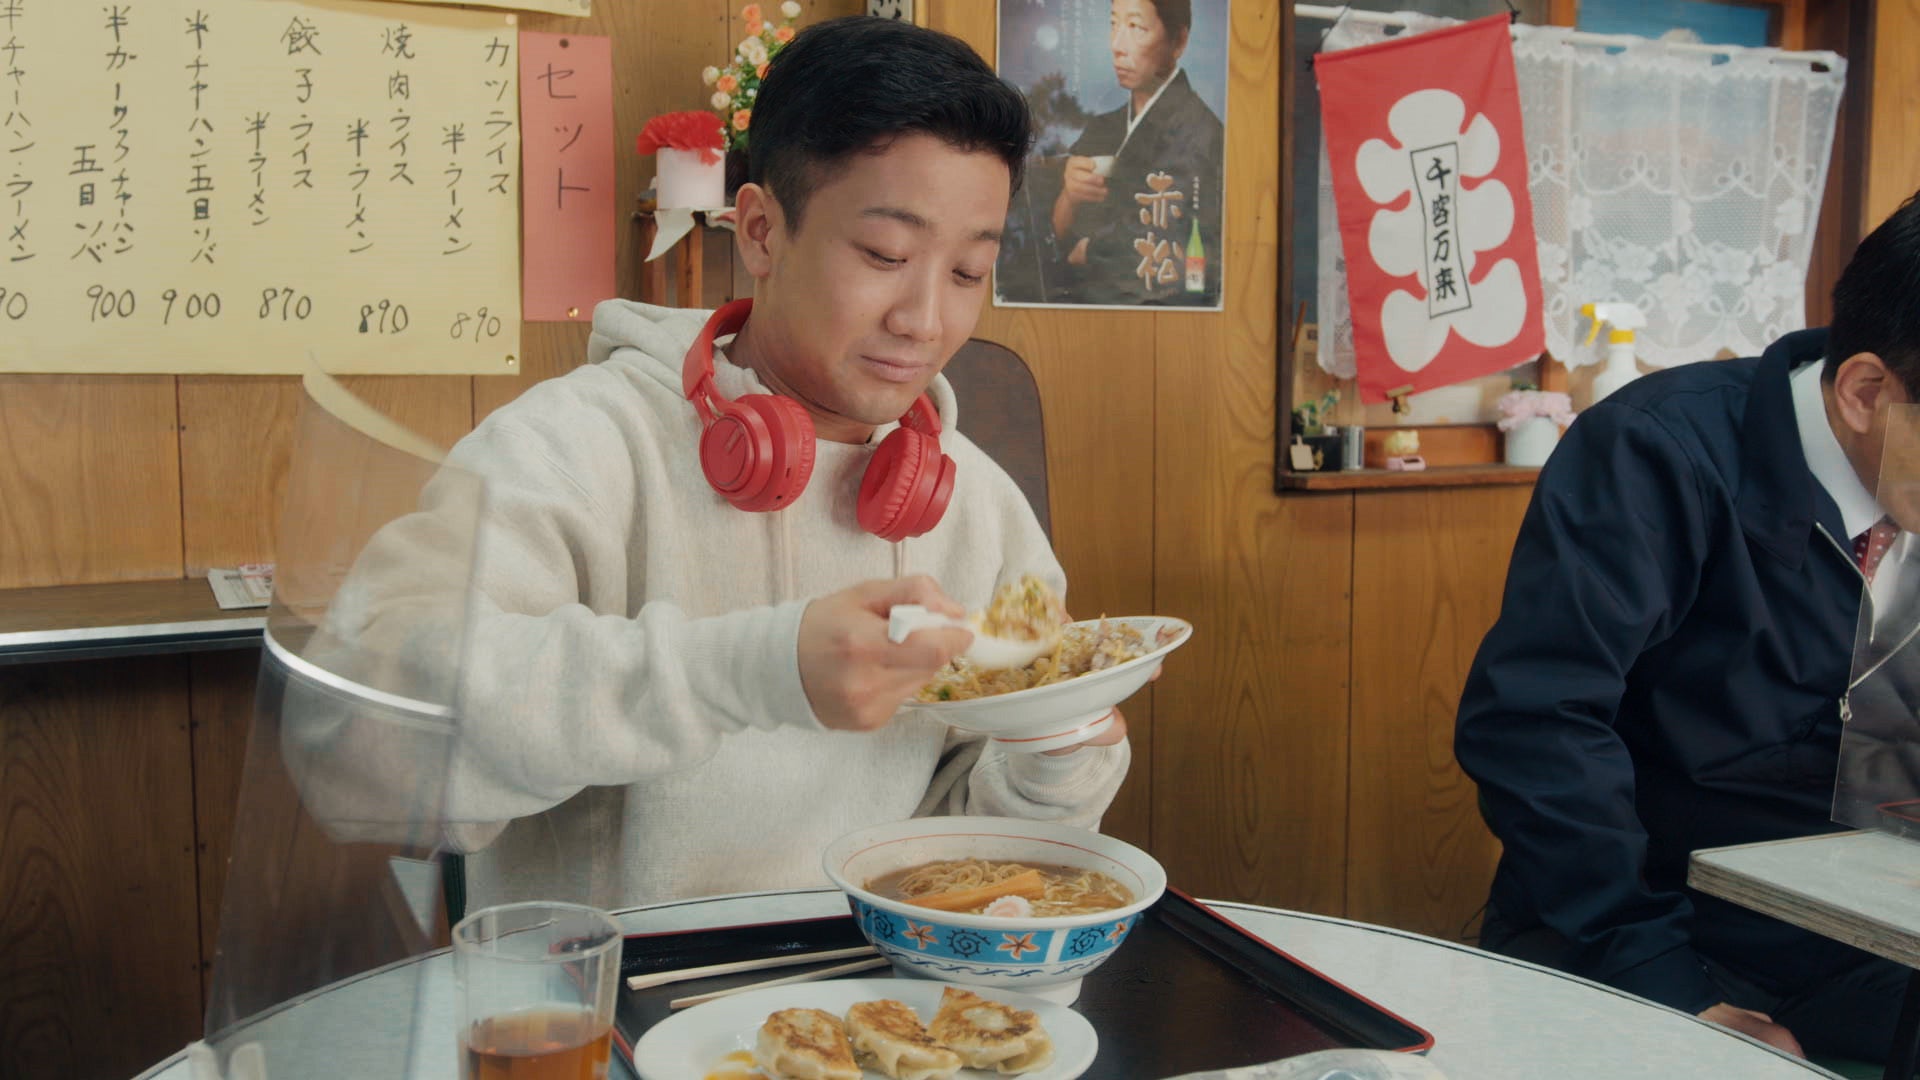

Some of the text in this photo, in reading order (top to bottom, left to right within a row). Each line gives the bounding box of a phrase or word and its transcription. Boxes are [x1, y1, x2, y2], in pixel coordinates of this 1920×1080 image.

[244, 111, 271, 227] 半ラーメン
[484, 37, 513, 195] カツライス
[537, 63, 590, 209] セット
[68, 144, 106, 264] 五目ソバ
[345, 117, 373, 254] 半ラーメン
[441, 122, 471, 256] 半ラーメン
[1133, 168, 1185, 292] 赤松
[1424, 154, 1458, 303] 千客万来
[86, 284, 136, 323] 900
[161, 288, 222, 325] 900
[258, 286, 312, 321] 870
[357, 298, 409, 335] 890
[450, 306, 501, 343] 890
